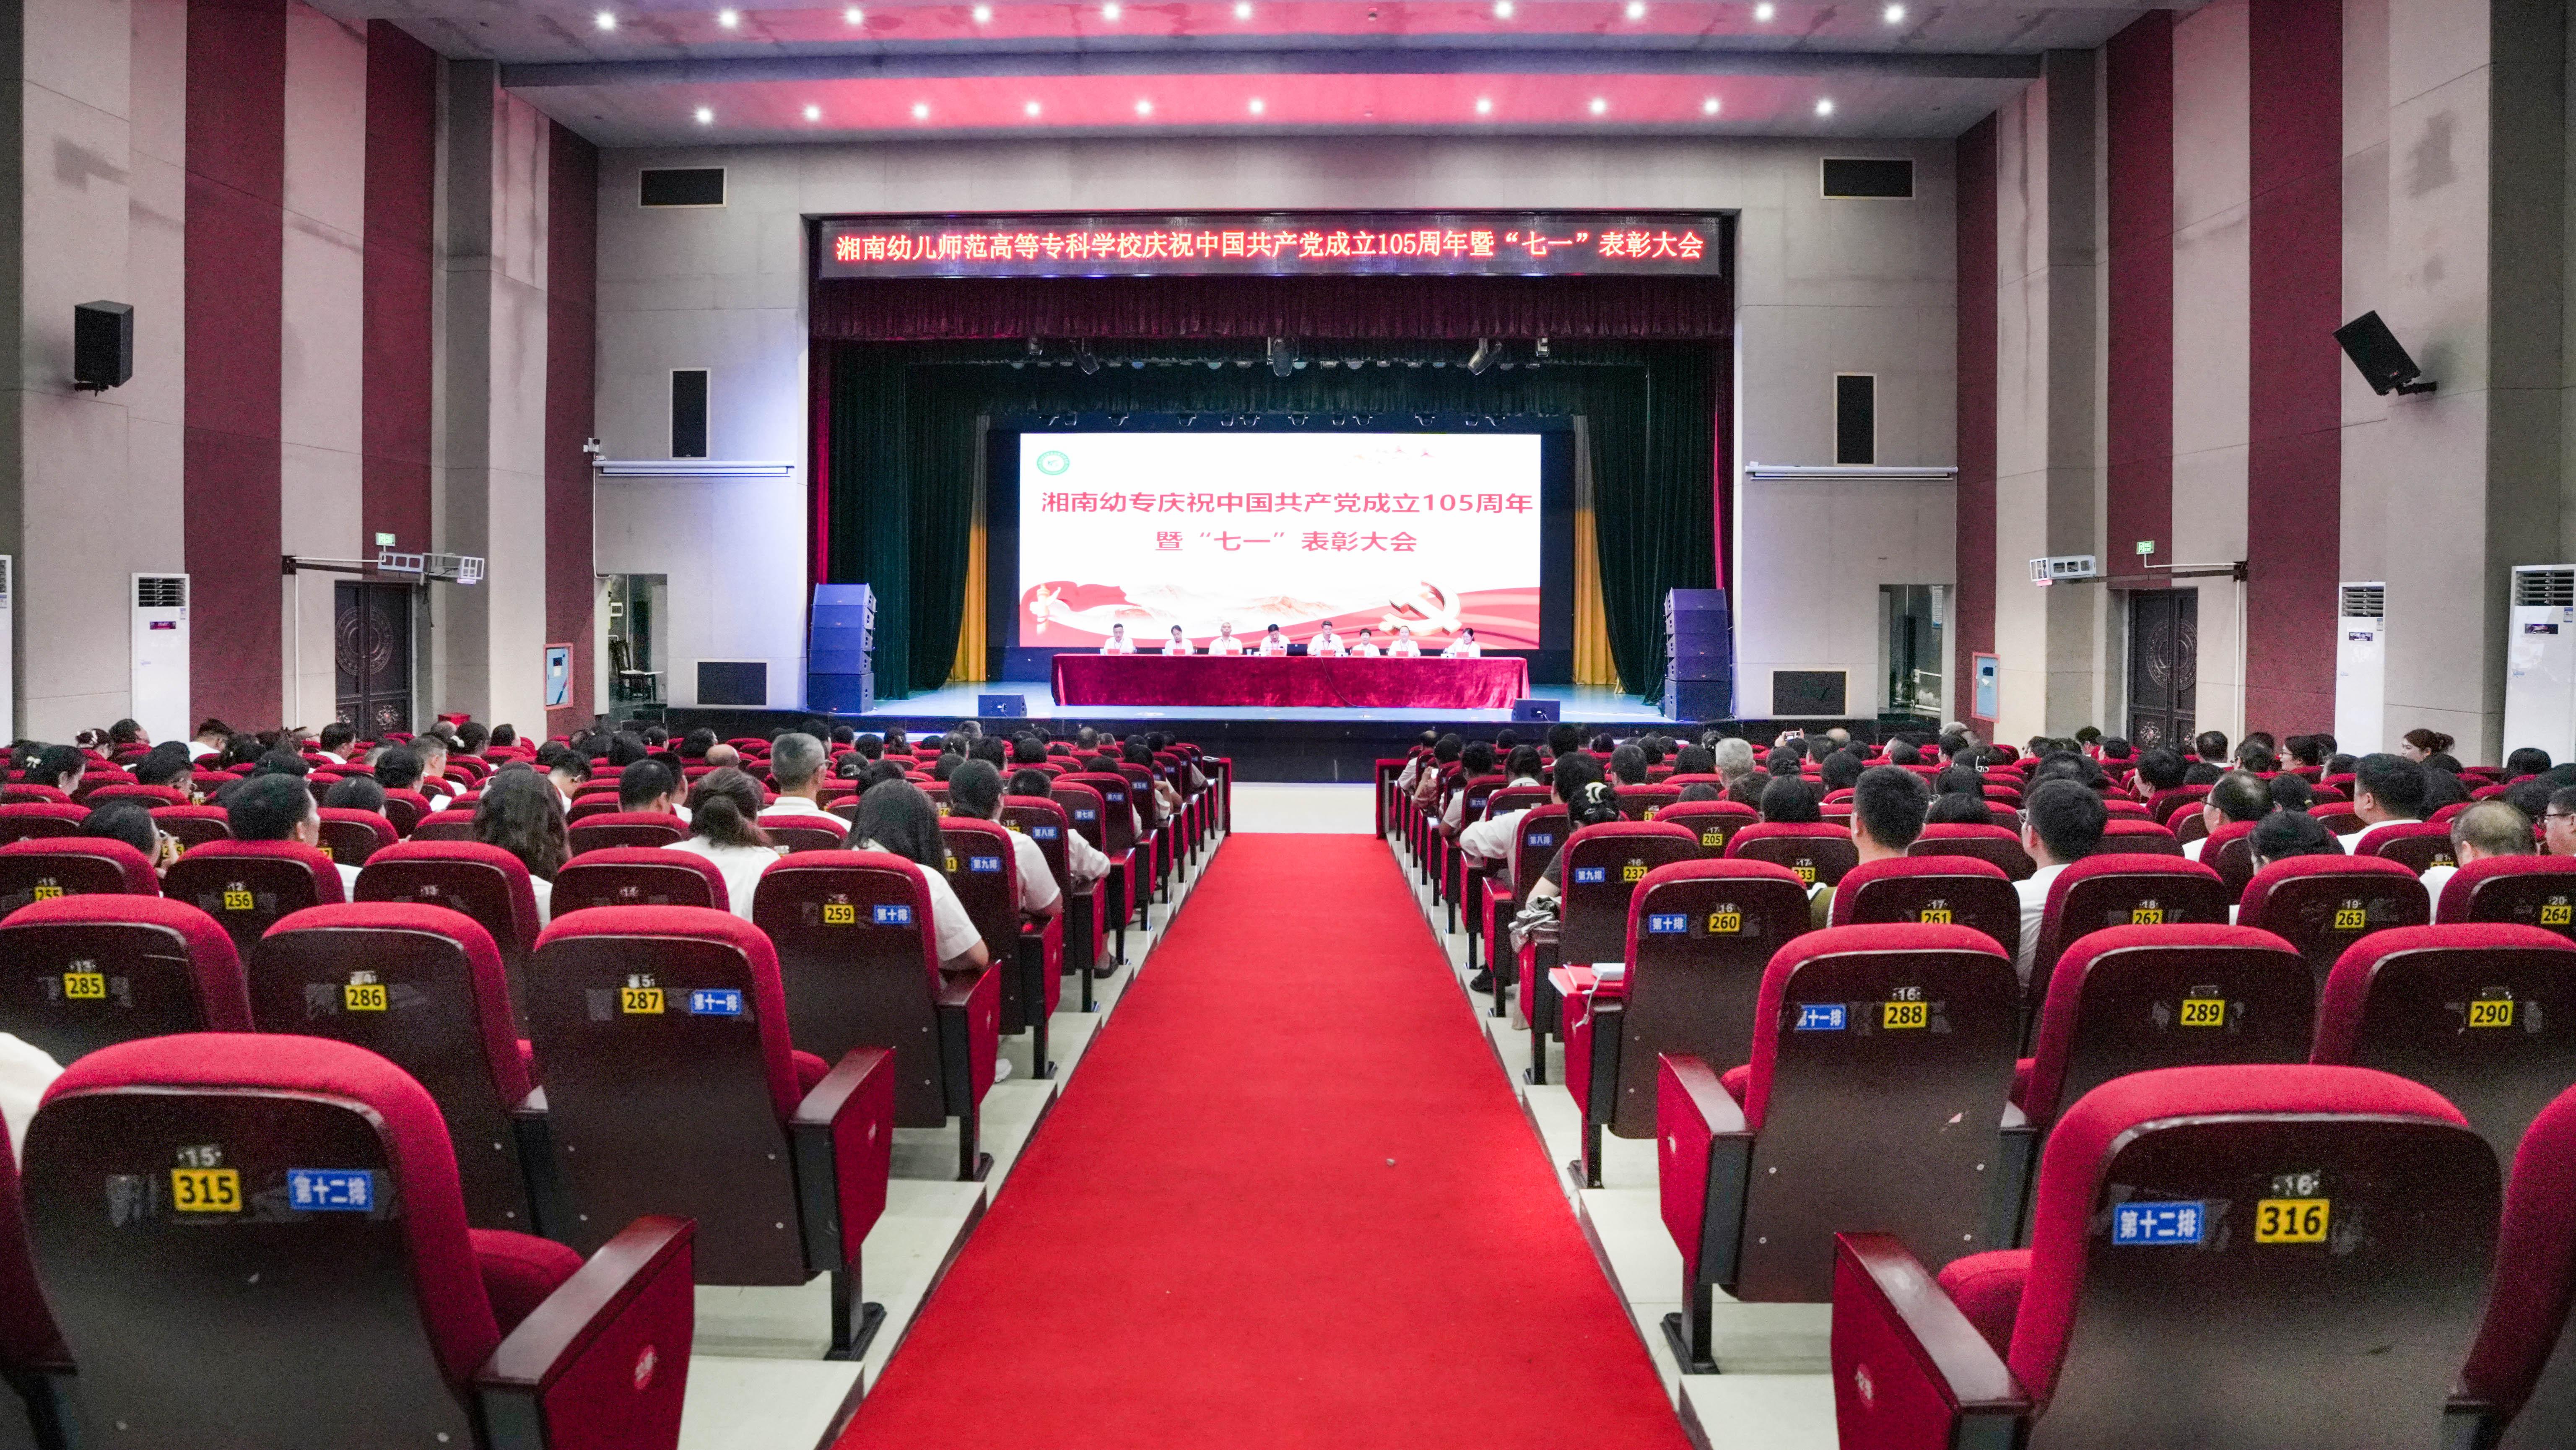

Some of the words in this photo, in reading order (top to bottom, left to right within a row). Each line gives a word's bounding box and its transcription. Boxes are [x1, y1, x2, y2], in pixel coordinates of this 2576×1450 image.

[836, 230, 1703, 261] 湘南幼儿师范高等专科学校庆祝中国共产党成立105周年暨“七一”表彰大会
[1041, 492, 1533, 514] 湘南幼专庆祝中国共产党成立105周年
[1156, 530, 1417, 553] 暨“七一”表彰大会
[1035, 829, 1054, 837] 第八排
[1530, 836, 1550, 844] 第八排
[1705, 835, 1720, 844] 205
[973, 859, 997, 869] 第九排
[1578, 871, 1602, 880] 第九排
[1626, 868, 1644, 879] 232
[227, 894, 250, 907] 256
[828, 908, 851, 920] 259
[877, 908, 908, 921] 第十排
[1924, 913, 1947, 923] 261
[2135, 912, 2159, 924] 262
[2338, 912, 2362, 926] 263
[2543, 908, 2568, 922] 264
[1652, 917, 1684, 930] 第十排
[1712, 916, 1737, 929] 260
[69, 977, 100, 995] 285
[350, 989, 382, 1006] 286
[627, 992, 658, 1009] 287
[694, 993, 737, 1011] 第十一排
[1888, 1006, 1922, 1024] 288
[2185, 1004, 2220, 1022] 289
[2474, 1004, 2508, 1023] 290
[179, 1175, 234, 1204] 315
[294, 1176, 366, 1205] 第十二排
[2121, 1209, 2197, 1239] 第十二排
[2262, 1206, 2321, 1236] 316
